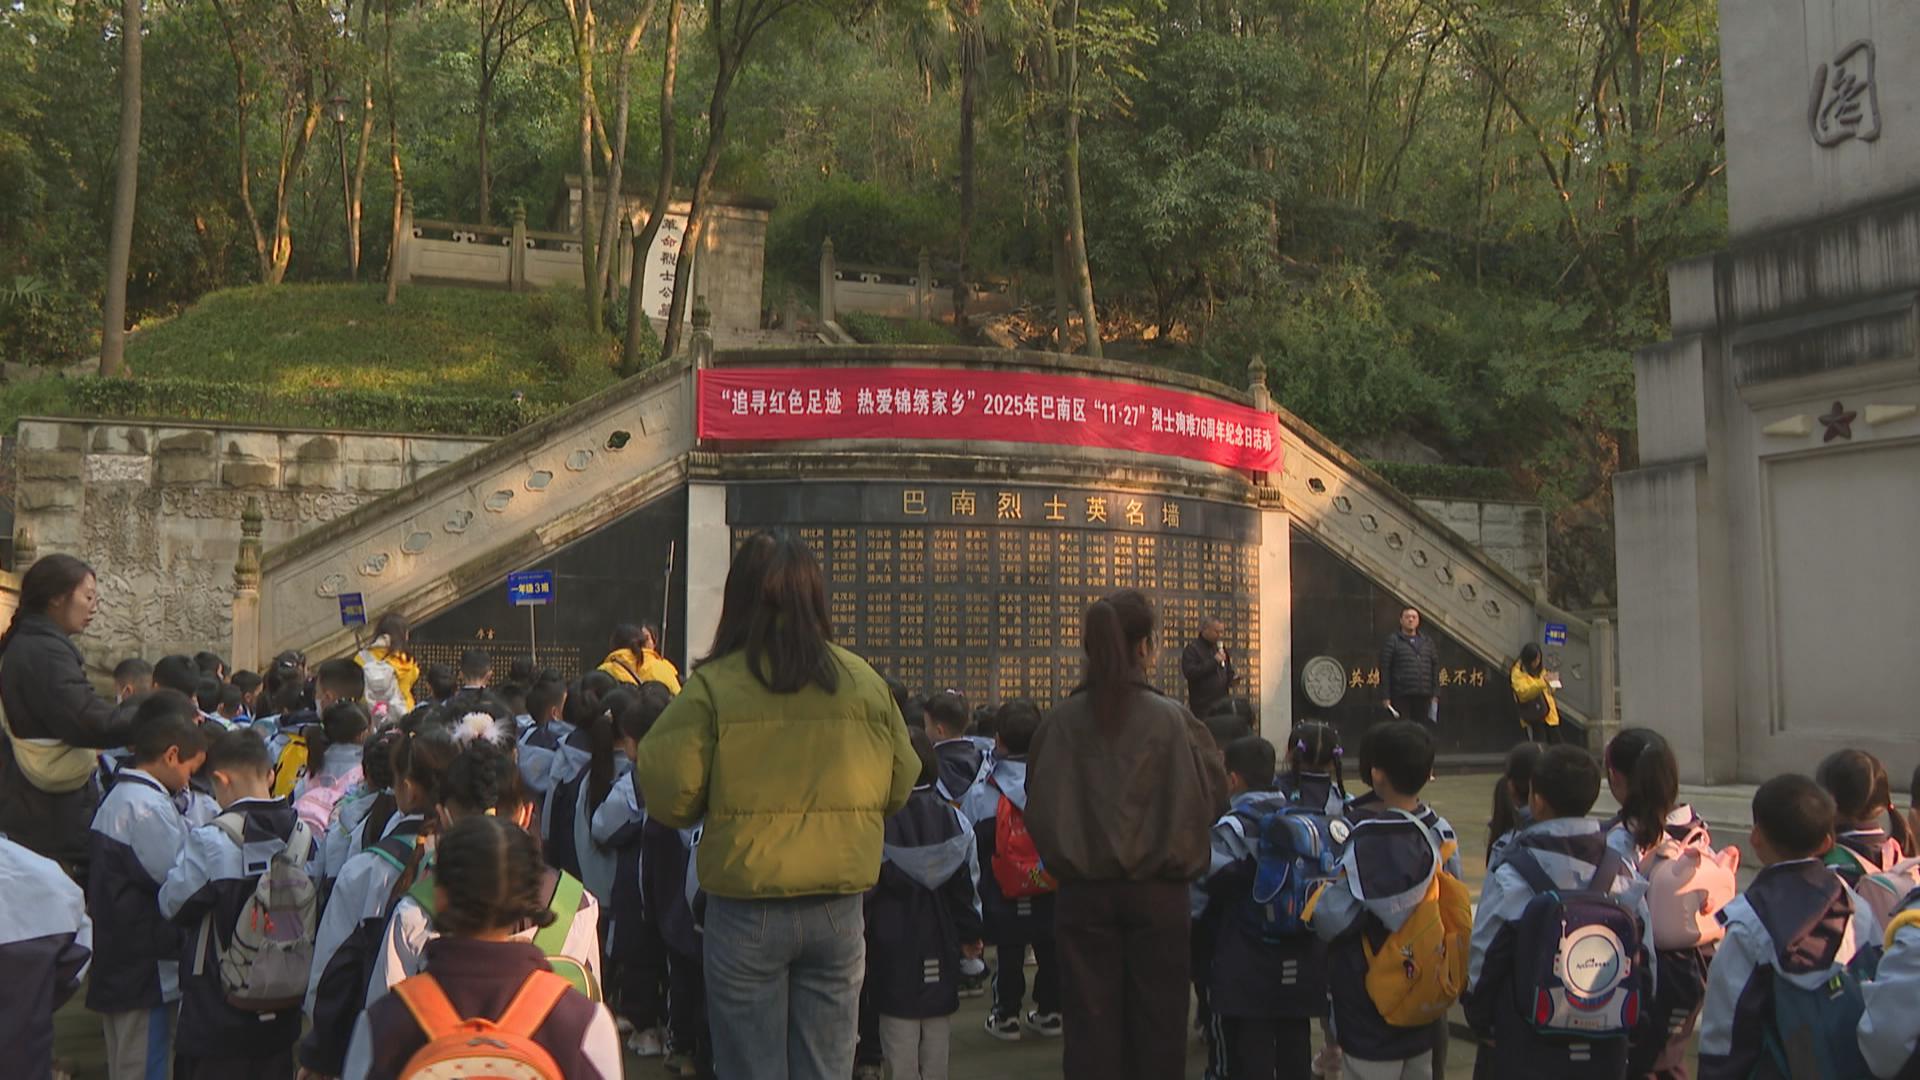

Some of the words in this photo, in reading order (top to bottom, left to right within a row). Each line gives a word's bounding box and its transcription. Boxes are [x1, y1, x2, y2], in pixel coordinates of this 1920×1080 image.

[721, 387, 843, 415] “追寻红色足迹
[857, 387, 977, 416] 热爱锦绣家乡”
[983, 393, 1087, 423] 2025年巴南区
[1151, 406, 1273, 453] 烈士殉难76周年纪念日活动
[903, 488, 1181, 529] 巴南烈士英名墙
